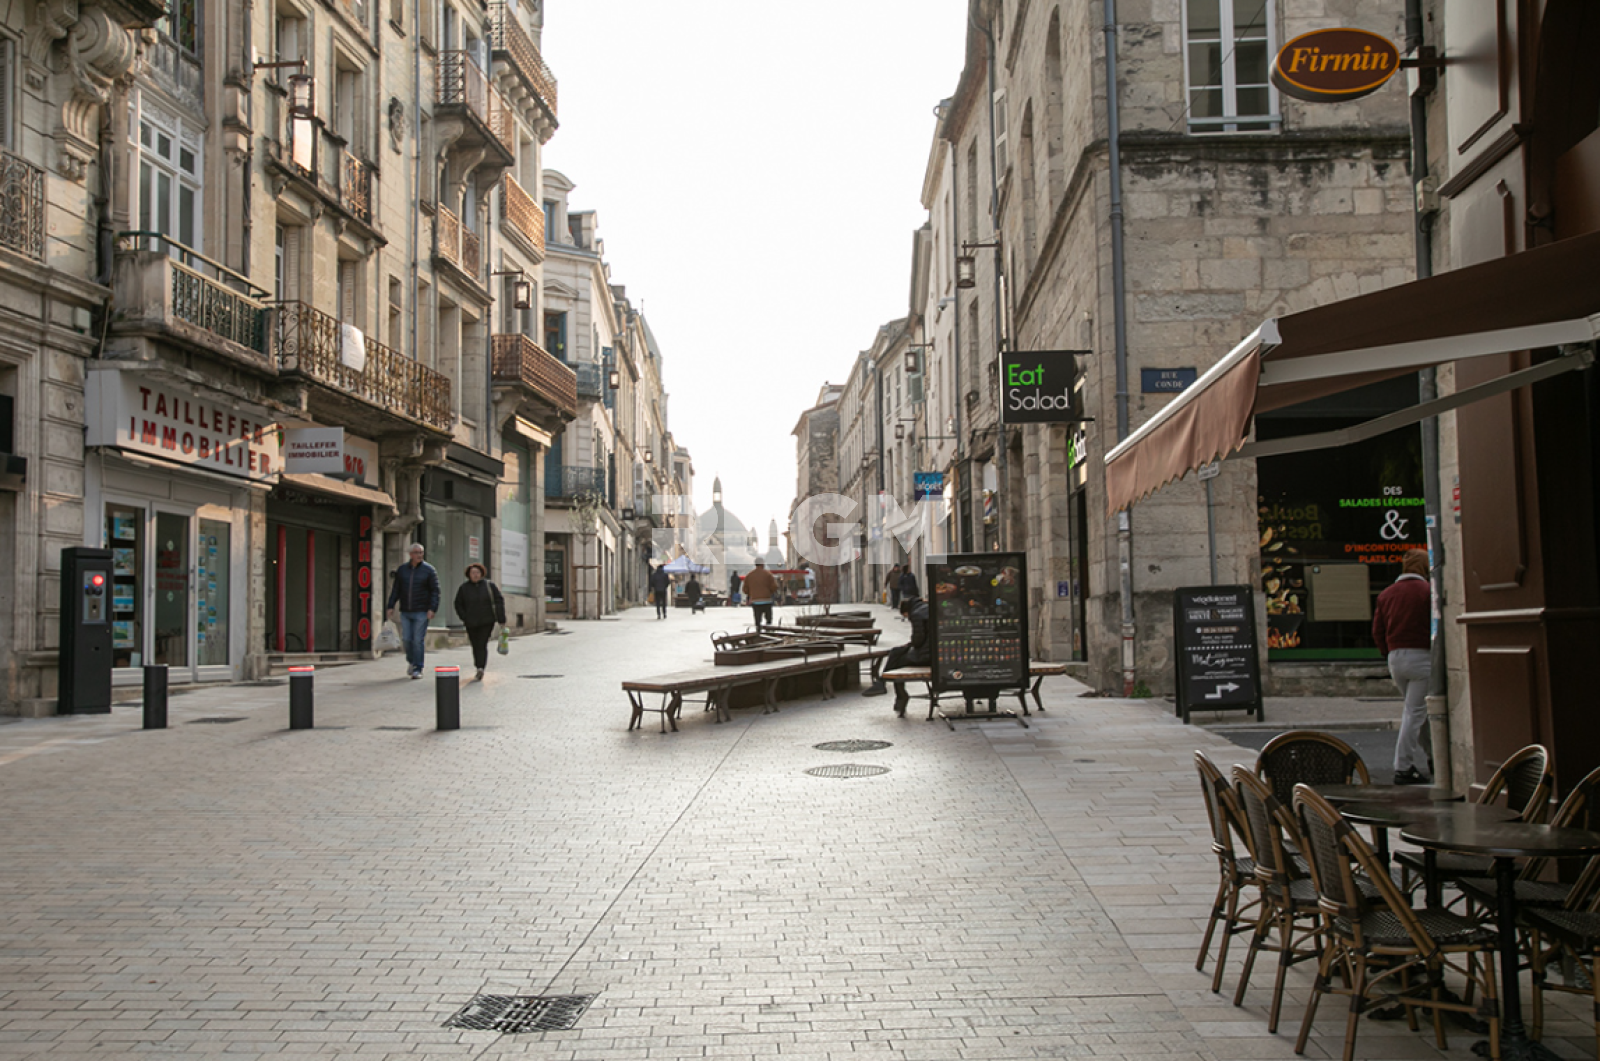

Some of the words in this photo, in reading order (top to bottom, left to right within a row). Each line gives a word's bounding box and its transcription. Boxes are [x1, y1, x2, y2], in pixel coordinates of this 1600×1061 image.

[1288, 45, 1389, 73] Firmin
[1007, 363, 1045, 386] Eat
[1161, 371, 1178, 379] RUE
[1009, 387, 1070, 411] Salad
[139, 386, 264, 445] TAILLEFER
[130, 416, 271, 475] IMMOBILIER
[288, 450, 340, 459] IMMOBILIER
[291, 441, 337, 450] TAILLEFER
[1338, 498, 1381, 507] SALADES
[1383, 486, 1402, 496] DES
[1379, 509, 1409, 540] &
[1358, 554, 1386, 563] PLATS
[358, 515, 371, 640] PHOTO
